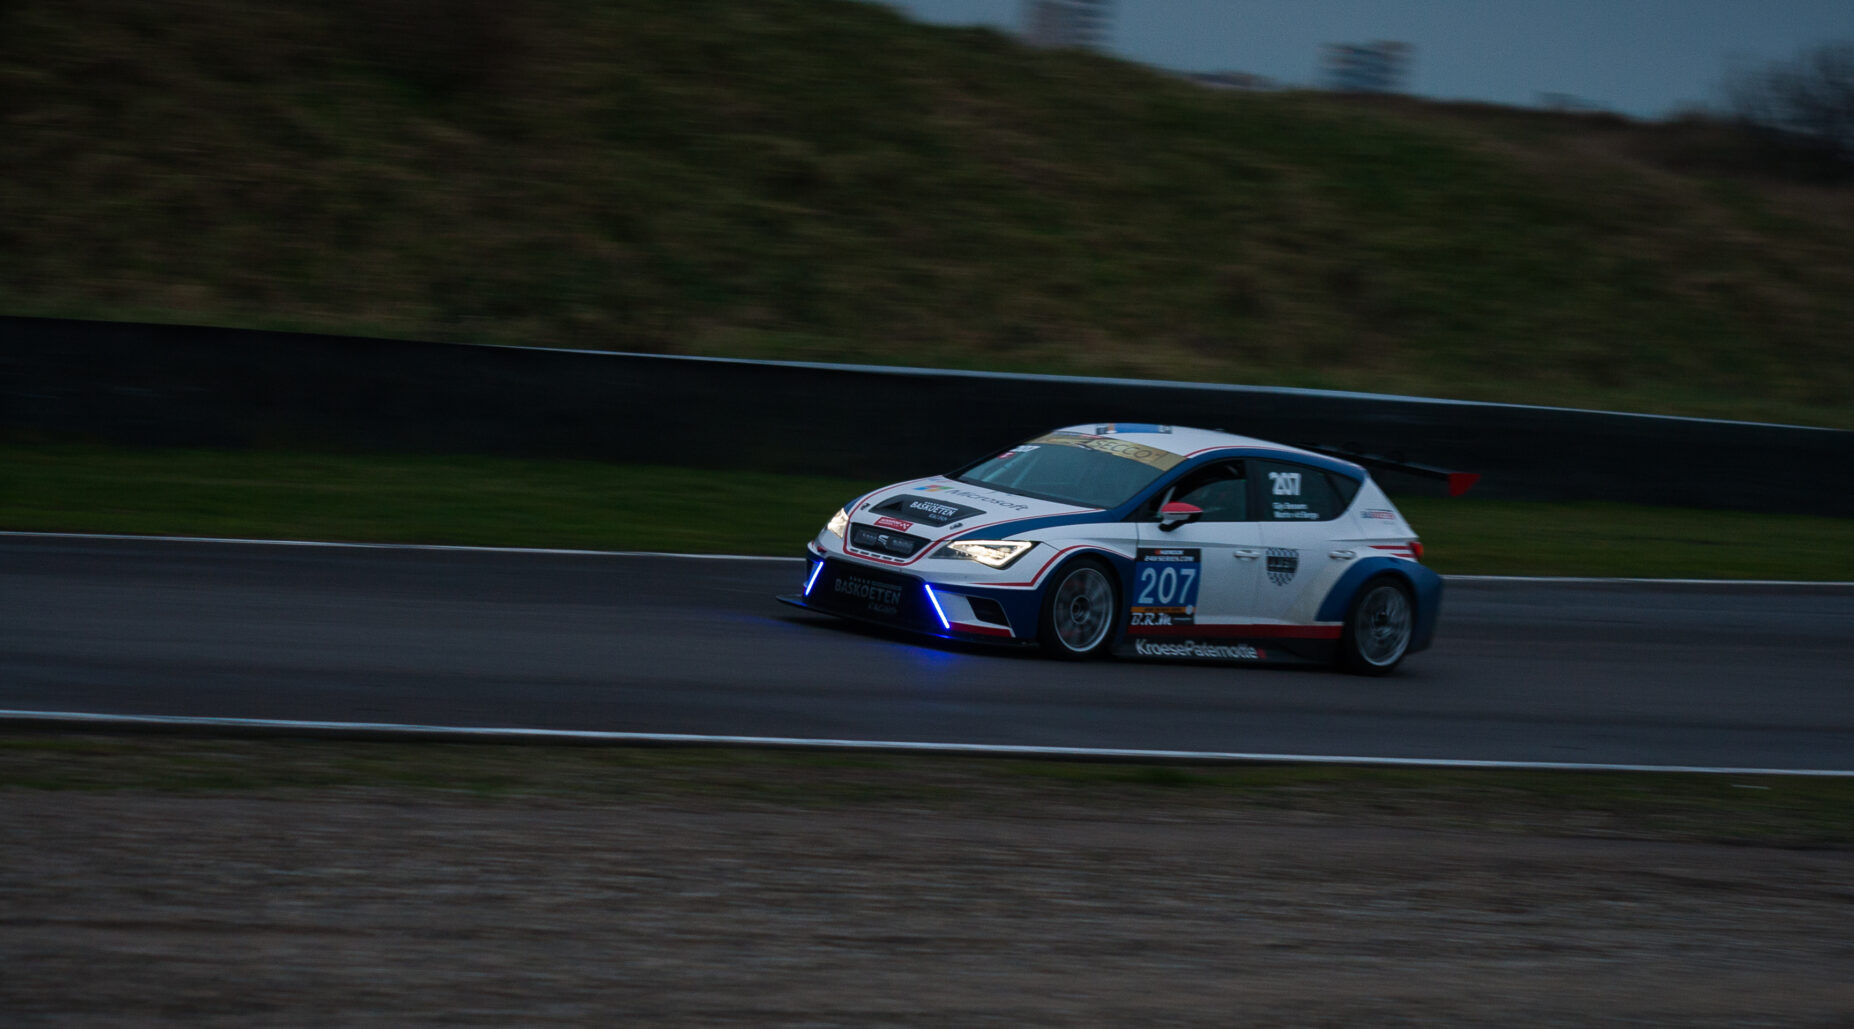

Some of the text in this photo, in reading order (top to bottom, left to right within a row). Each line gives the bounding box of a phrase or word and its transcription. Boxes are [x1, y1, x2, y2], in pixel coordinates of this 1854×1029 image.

[1267, 471, 1302, 496] 207
[909, 500, 957, 517] BASKOETEN
[944, 489, 1029, 511] Microsoft
[834, 577, 902, 608] BASKOETEN
[1137, 566, 1197, 605] 207
